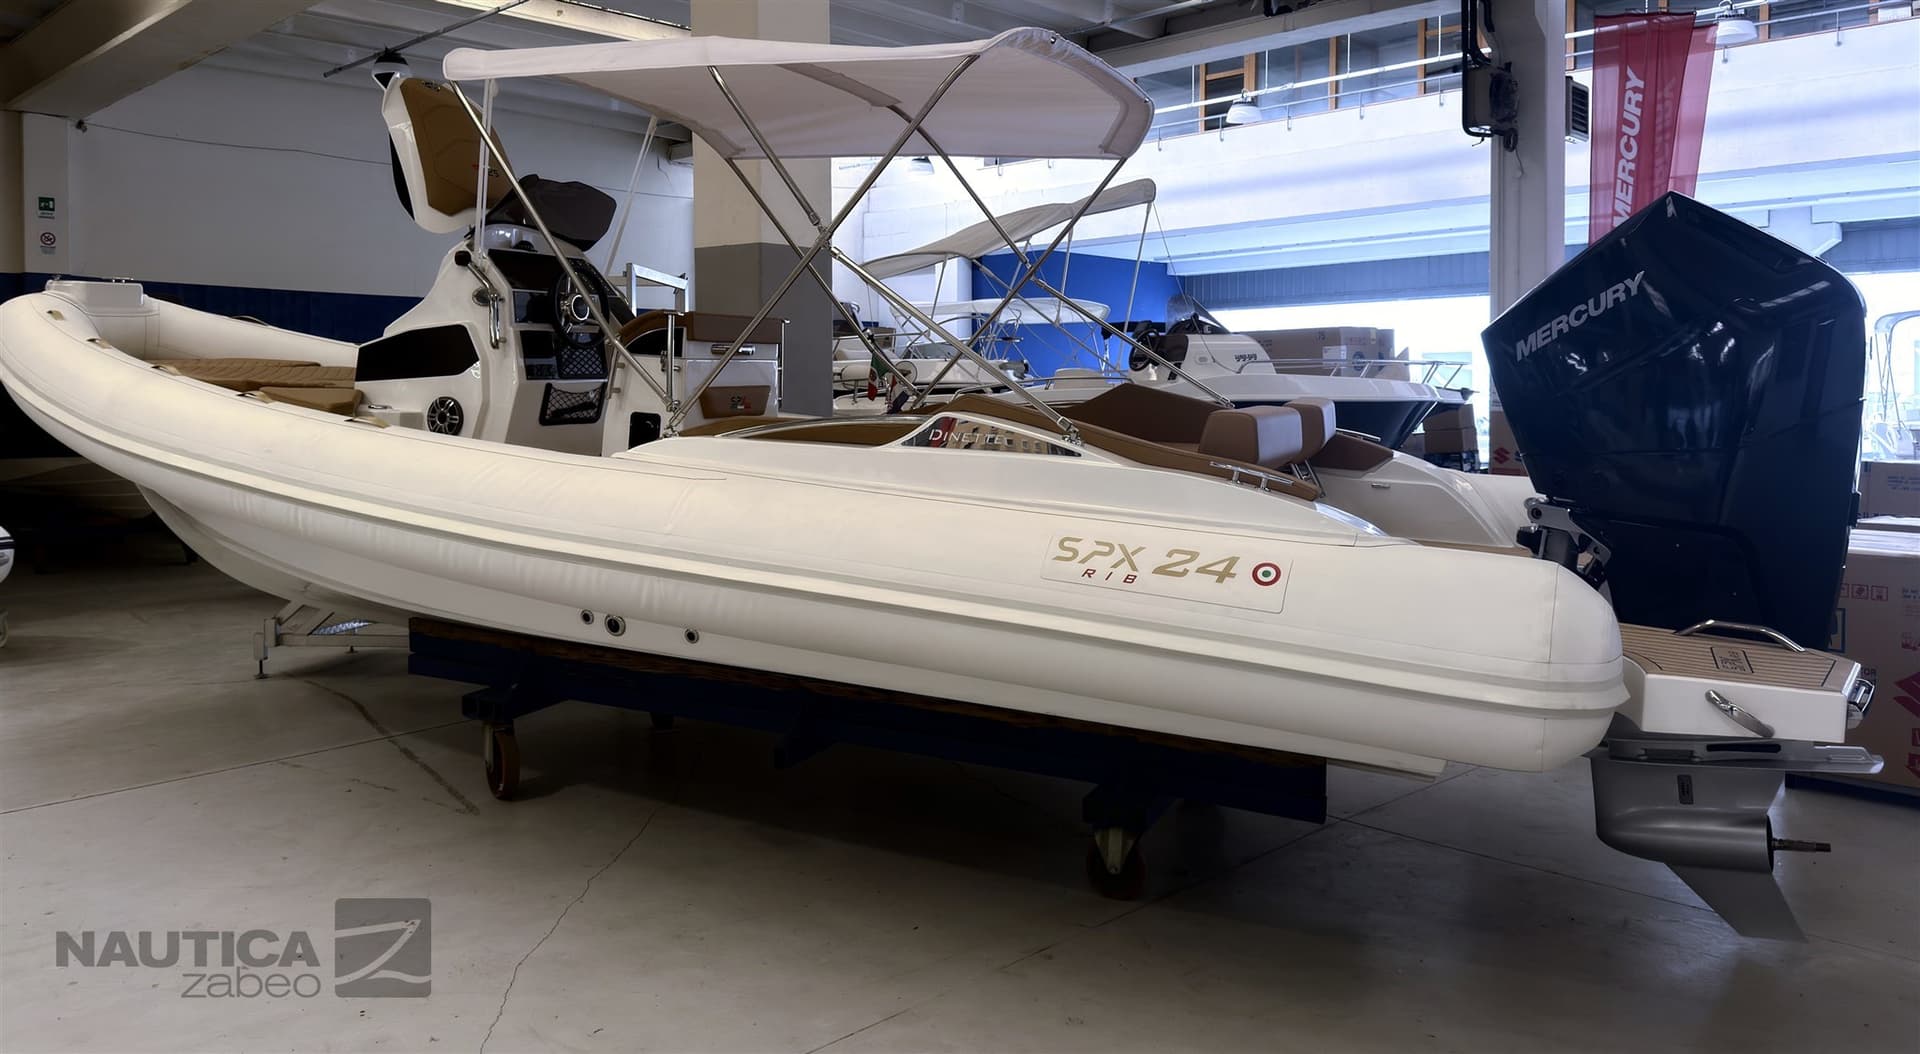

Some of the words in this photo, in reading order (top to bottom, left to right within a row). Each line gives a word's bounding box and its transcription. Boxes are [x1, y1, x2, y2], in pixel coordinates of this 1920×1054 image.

[1613, 66, 1645, 228] MERCURY
[1515, 270, 1645, 362] MERCURY
[929, 429, 1005, 445] DINETTE
[1052, 537, 1147, 572] SPX
[1152, 549, 1241, 584] 24
[1081, 568, 1138, 584] RIB
